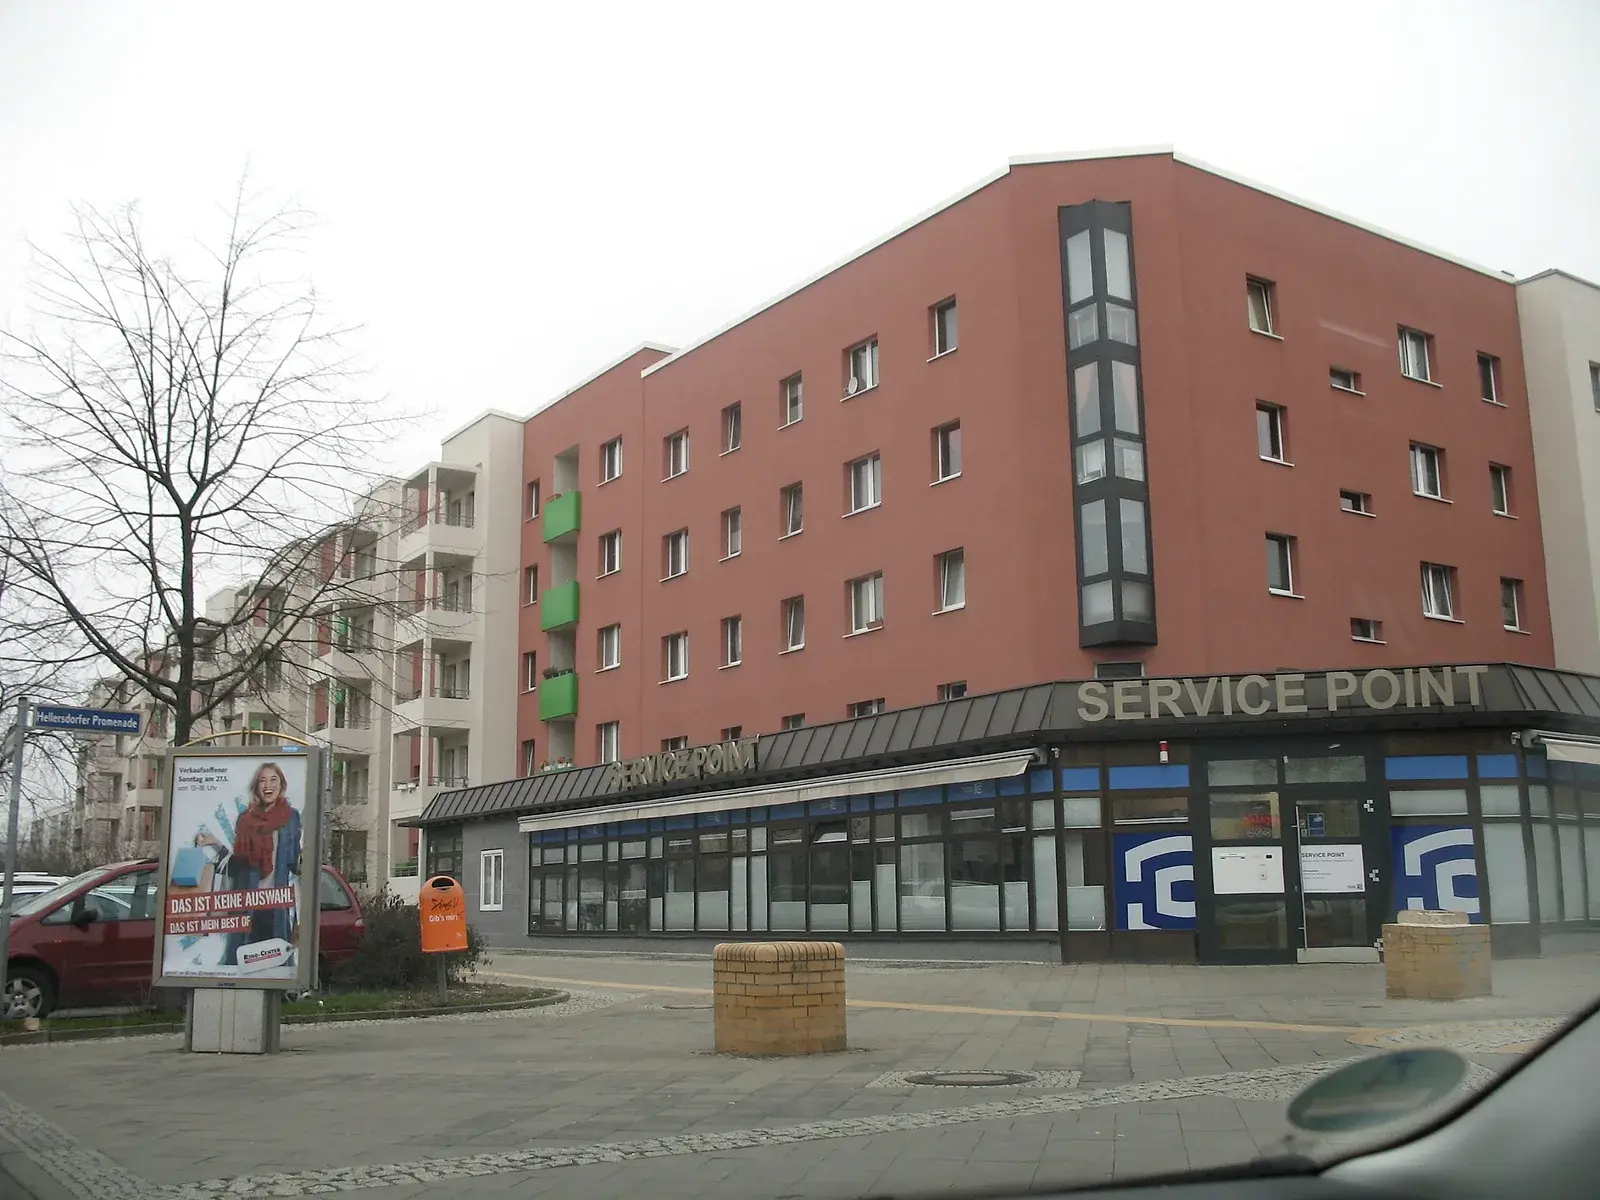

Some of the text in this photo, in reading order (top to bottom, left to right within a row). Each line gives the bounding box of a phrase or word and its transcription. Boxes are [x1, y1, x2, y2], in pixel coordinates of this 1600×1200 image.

[1076, 665, 1489, 722] SERVICE POINT
[36, 711, 138, 728] Hellersdorfer Promenade
[610, 734, 760, 792] SERVICE POINT
[171, 887, 294, 914] DAS IST KEINE AUSWAHL
[170, 915, 252, 934] DAS IST MEIN BEST OF
